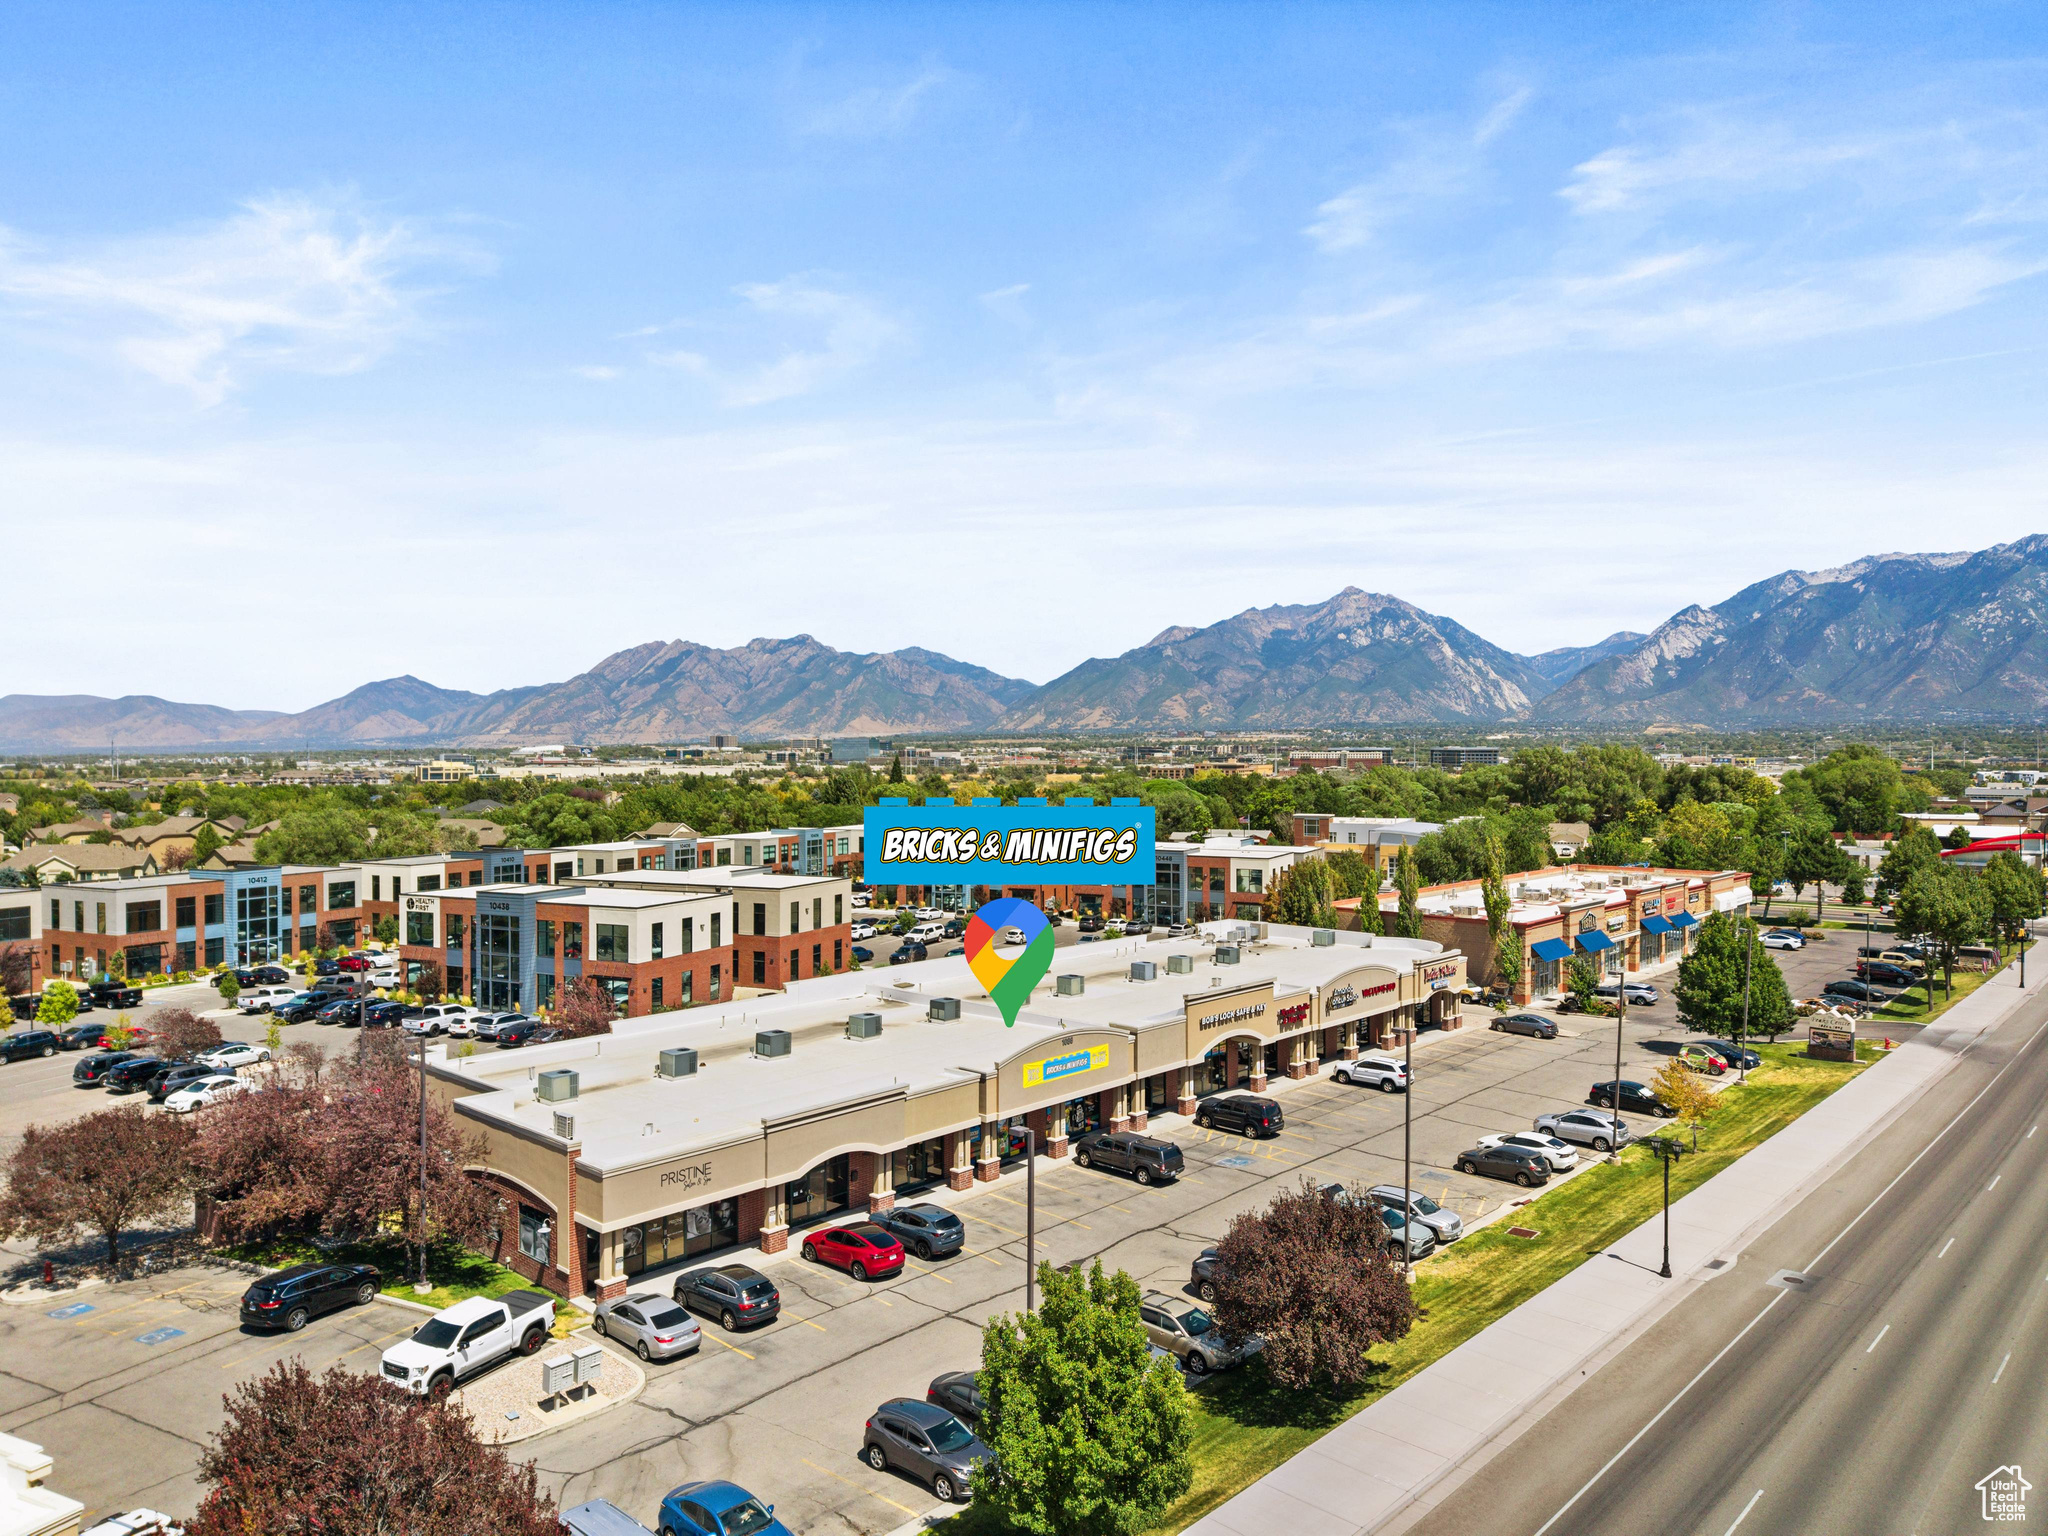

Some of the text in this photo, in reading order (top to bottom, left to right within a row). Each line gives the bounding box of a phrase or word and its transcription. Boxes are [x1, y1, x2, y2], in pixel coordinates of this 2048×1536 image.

[247, 876, 268, 884] 10412
[489, 901, 510, 911] 10438
[1200, 1015, 1219, 1025] BOB'S
[1219, 1011, 1235, 1021] LOCK
[1236, 1007, 1250, 1017] SAFE
[1256, 1003, 1267, 1012] KEY
[1046, 1063, 1062, 1075] BRICKS
[1066, 1058, 1088, 1070] MINIFIGS
[660, 1161, 712, 1188] PRISTINE
